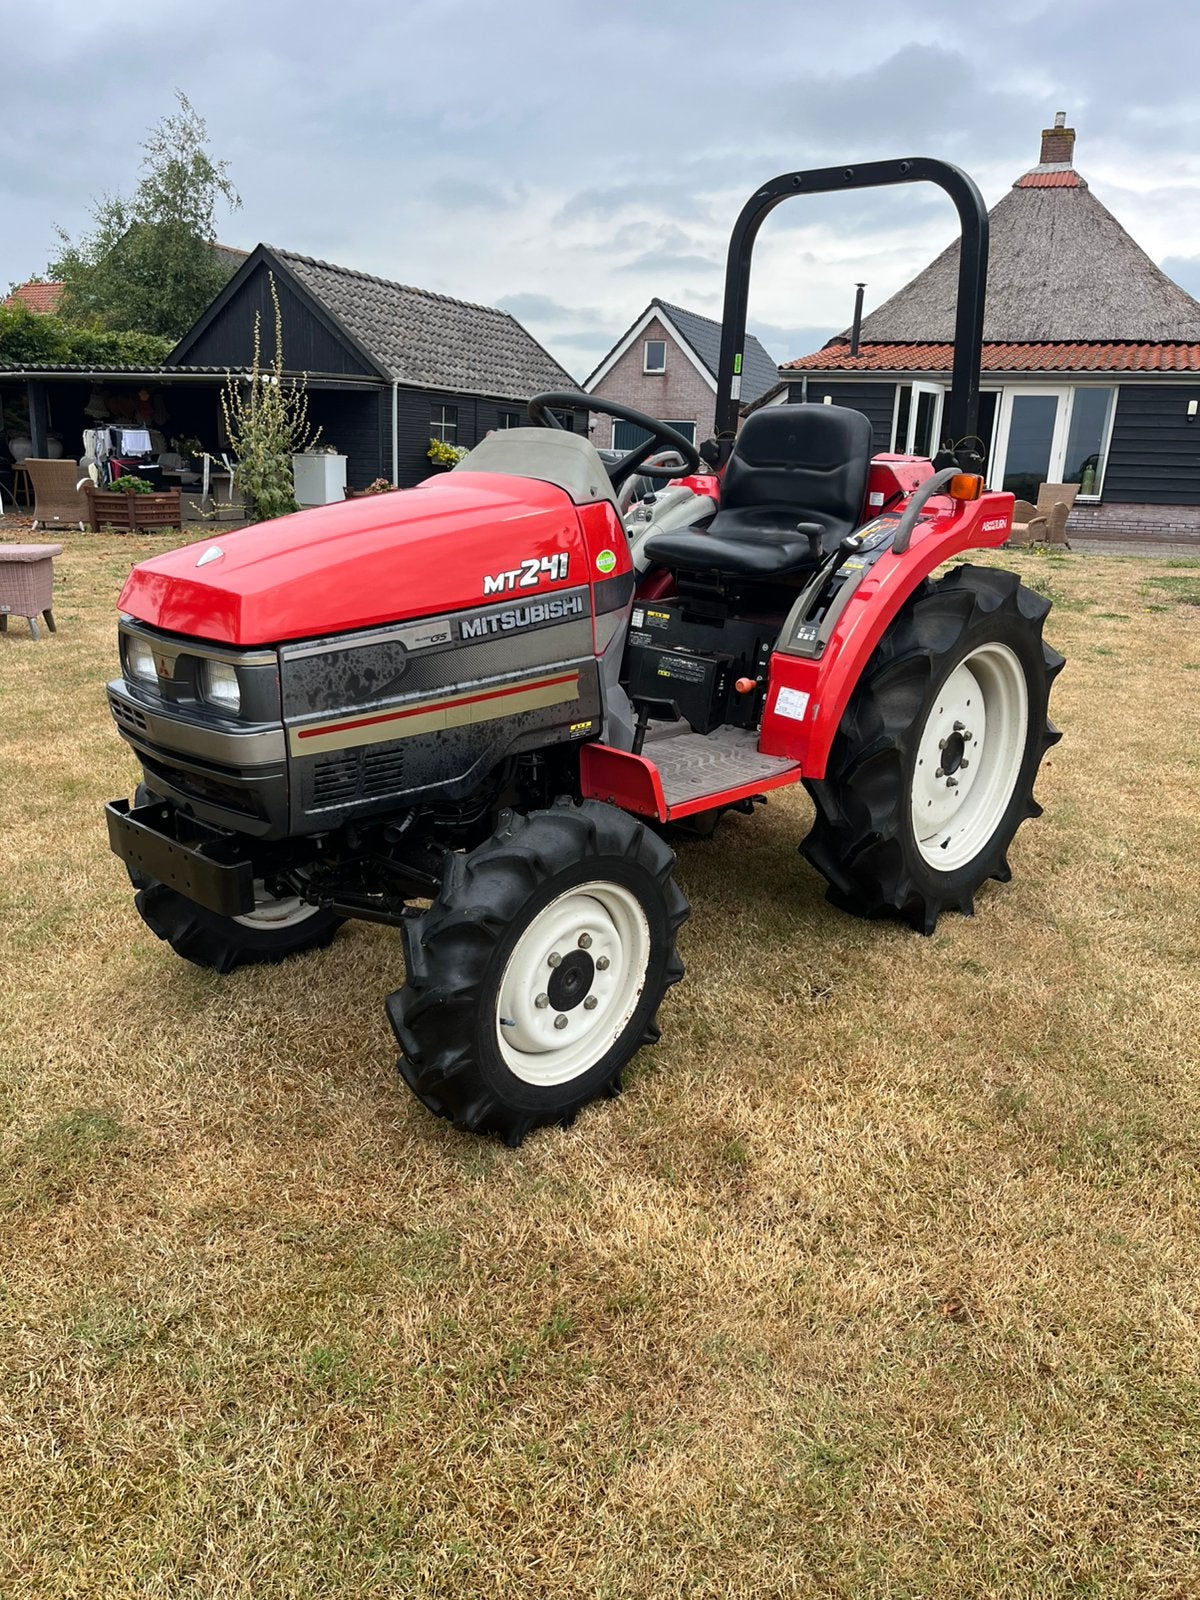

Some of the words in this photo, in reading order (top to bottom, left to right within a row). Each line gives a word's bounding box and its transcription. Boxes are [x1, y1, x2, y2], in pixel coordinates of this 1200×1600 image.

[483, 552, 569, 595] MT241
[431, 632, 447, 642] GS
[461, 596, 583, 639] MITSUBISHI
